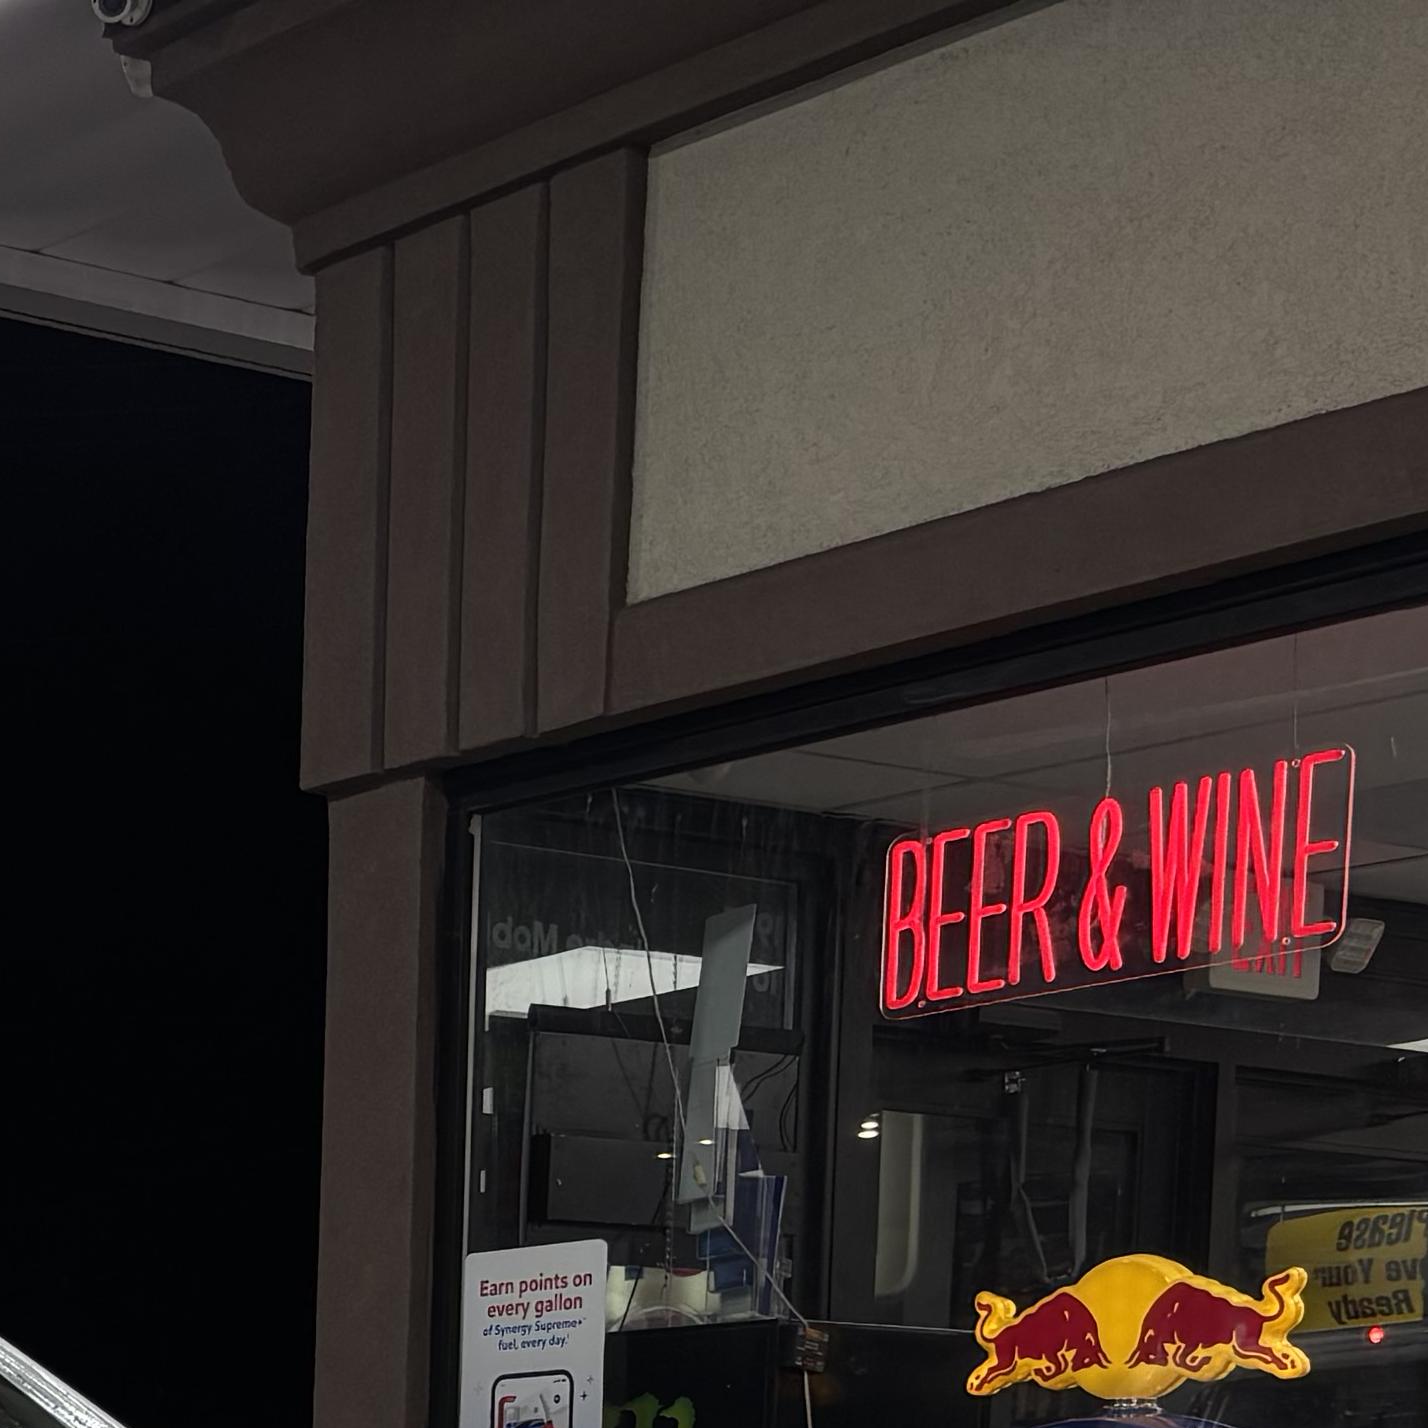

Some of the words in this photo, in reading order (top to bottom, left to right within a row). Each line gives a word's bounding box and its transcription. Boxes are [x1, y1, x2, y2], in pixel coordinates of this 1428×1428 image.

[884, 810, 1061, 1010] BEER
[1077, 796, 1128, 972] &
[1148, 748, 1346, 964] WINE
[480, 1280, 514, 1297] Earn
[519, 1273, 568, 1299] points
[572, 1273, 593, 1287] on
[487, 1302, 530, 1320] every
[535, 1293, 583, 1318] gallon
[483, 1325, 493, 1336] of
[494, 1324, 532, 1337] Synergy
[520, 1338, 546, 1350] every
